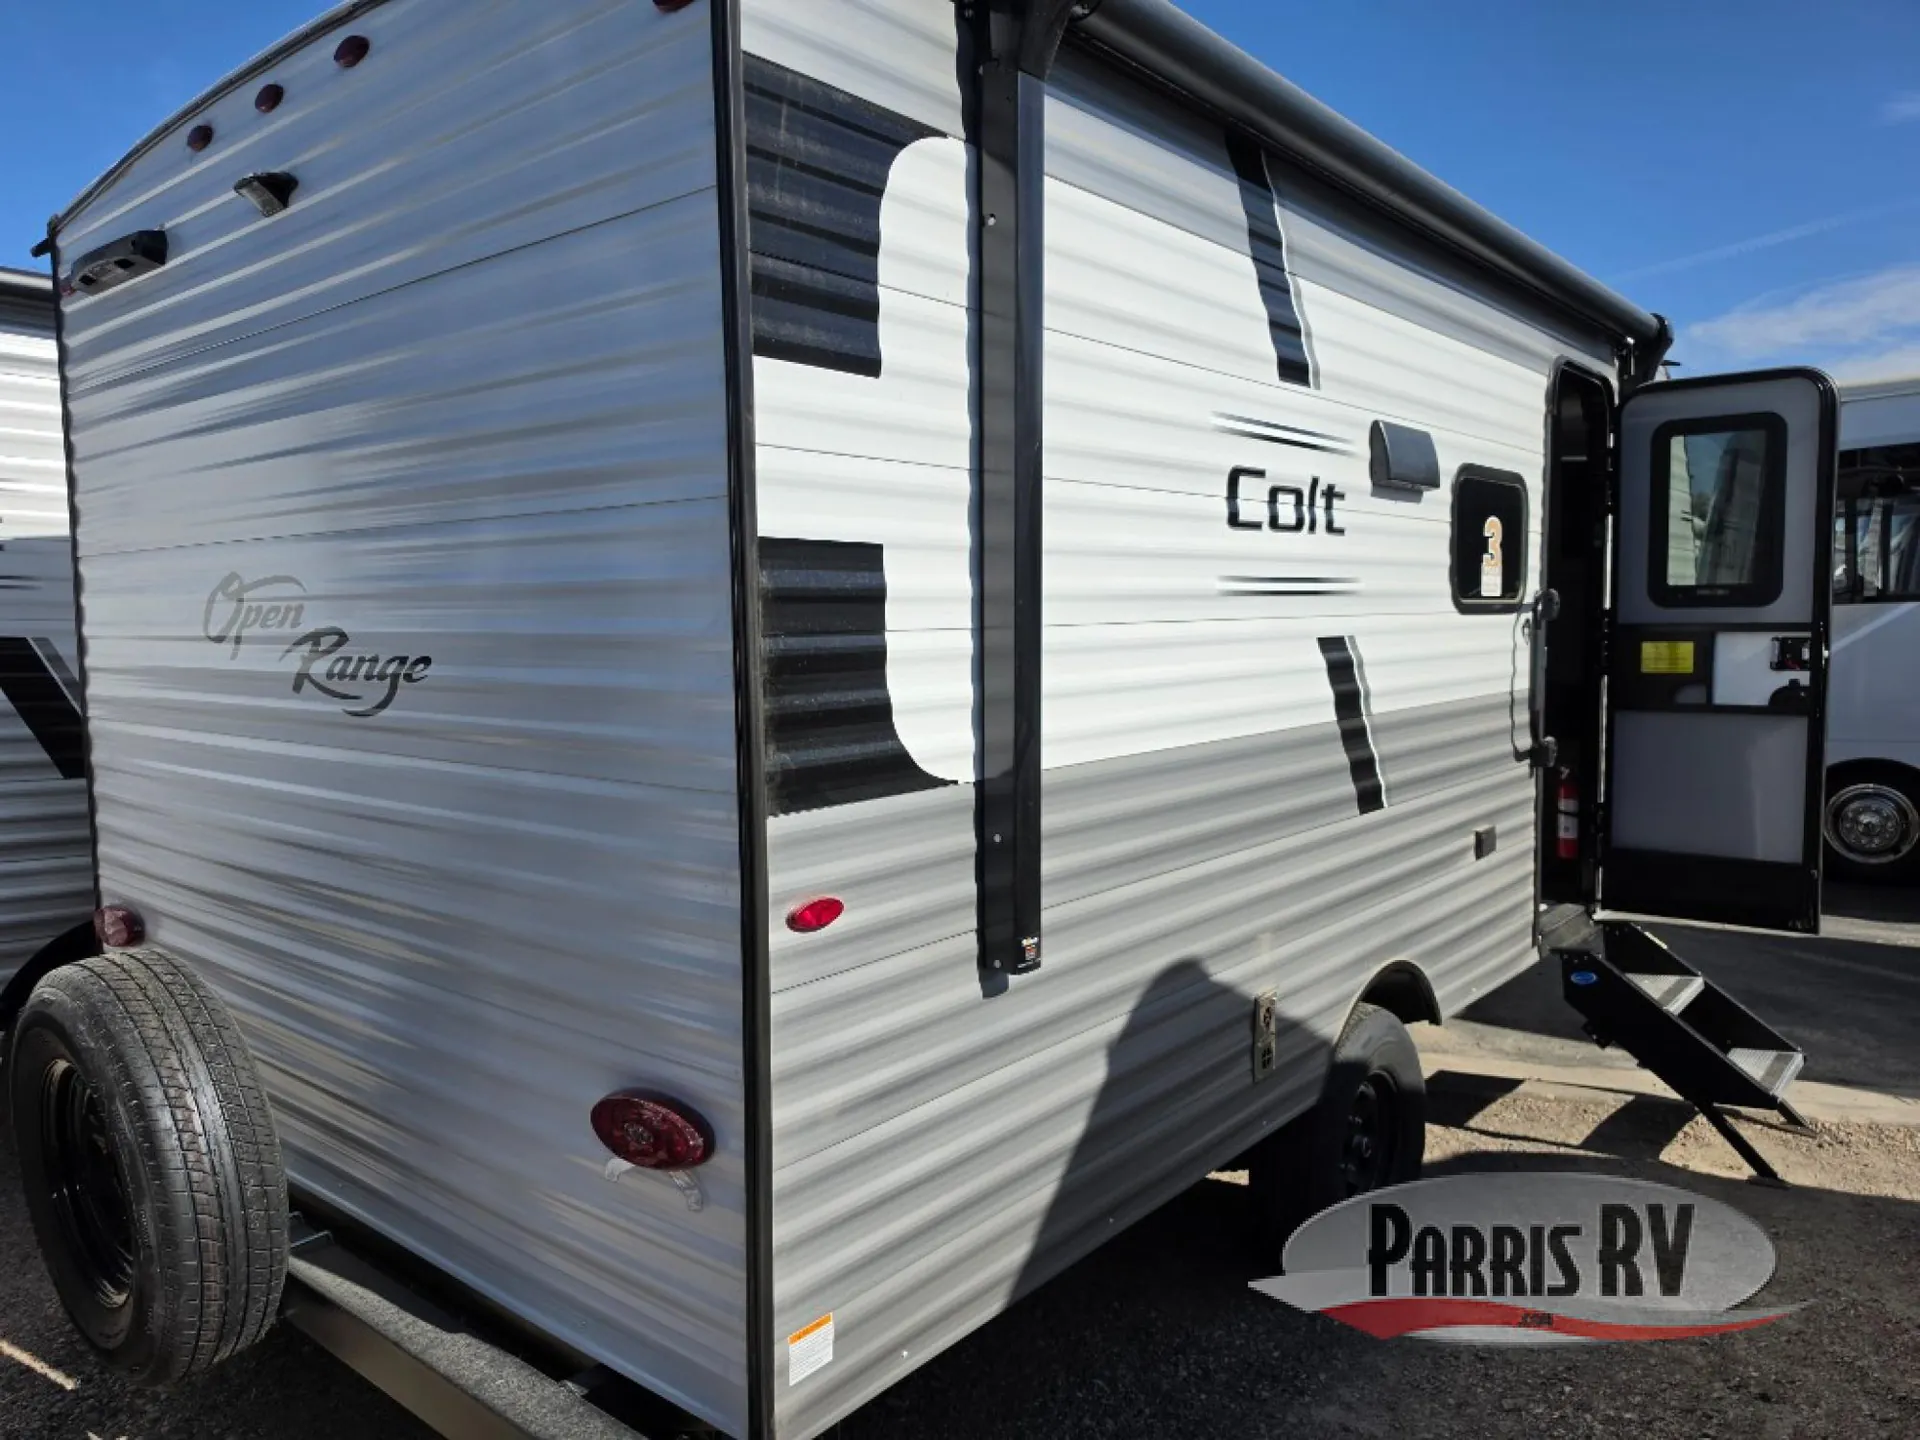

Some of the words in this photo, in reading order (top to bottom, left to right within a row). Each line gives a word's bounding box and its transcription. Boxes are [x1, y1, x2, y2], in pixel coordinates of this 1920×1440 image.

[1226, 465, 1346, 536] Colt
[1482, 515, 1502, 570] 3
[203, 570, 308, 662] Open
[279, 625, 433, 718] Range
